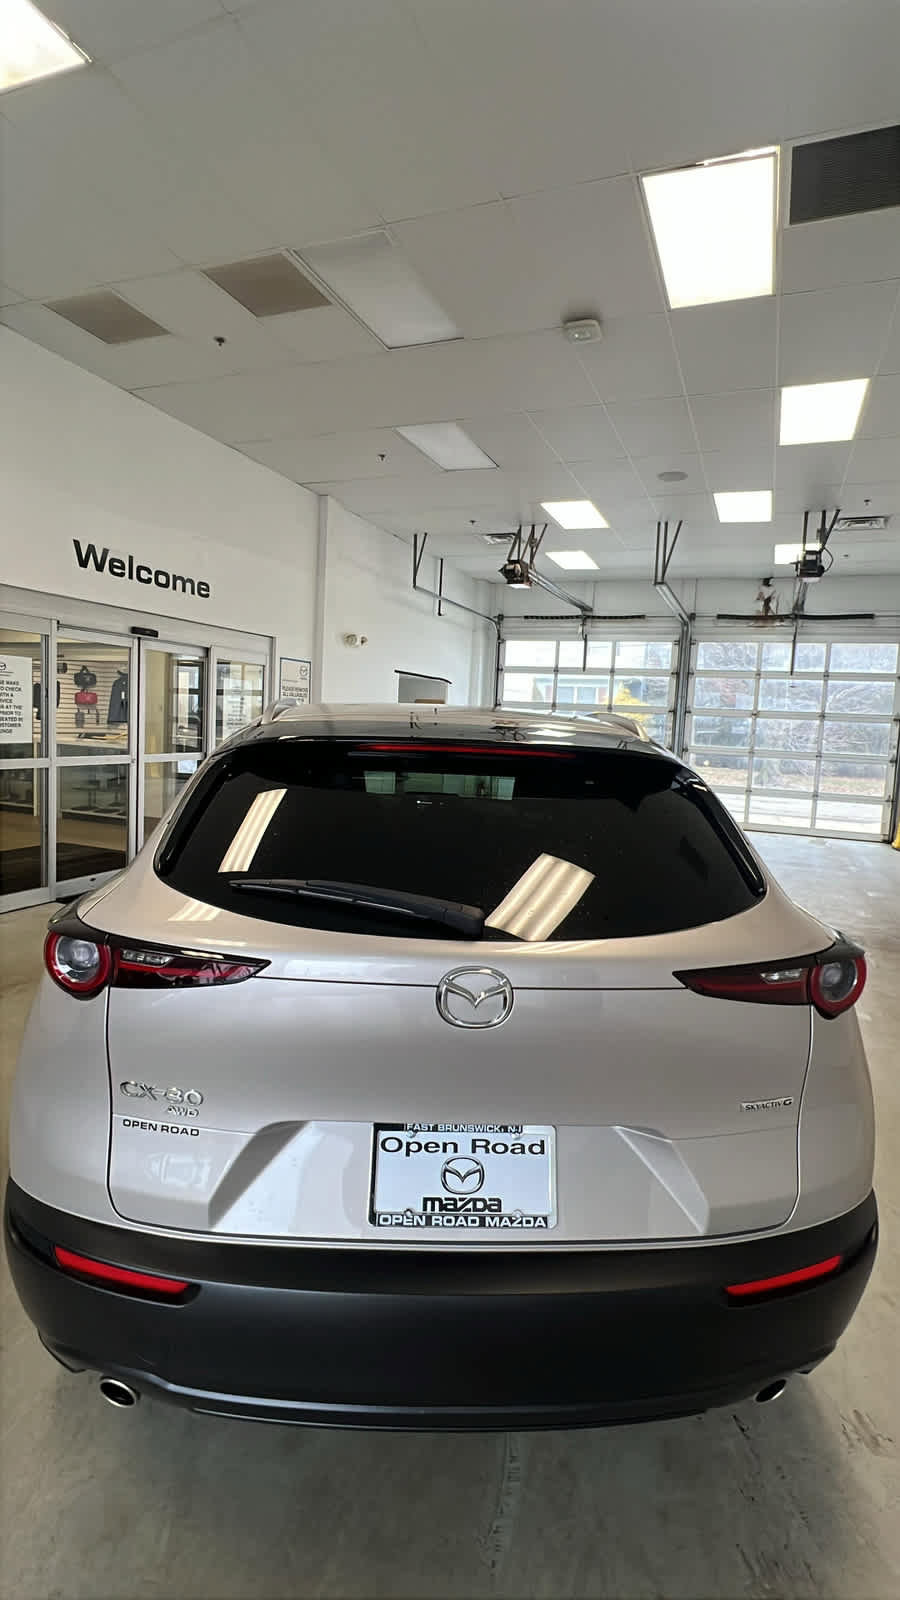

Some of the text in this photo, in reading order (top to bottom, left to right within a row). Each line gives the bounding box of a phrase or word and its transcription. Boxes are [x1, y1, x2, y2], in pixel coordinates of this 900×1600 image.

[73, 538, 210, 599] Welcome
[120, 1080, 204, 1105] CX-30
[167, 1104, 199, 1118] AWD
[122, 1118, 200, 1137] OPEN ROAD
[380, 1136, 545, 1157] Open Road
[422, 1196, 502, 1213] mazda
[378, 1213, 546, 1228] OPEN ROAD MAZDA
